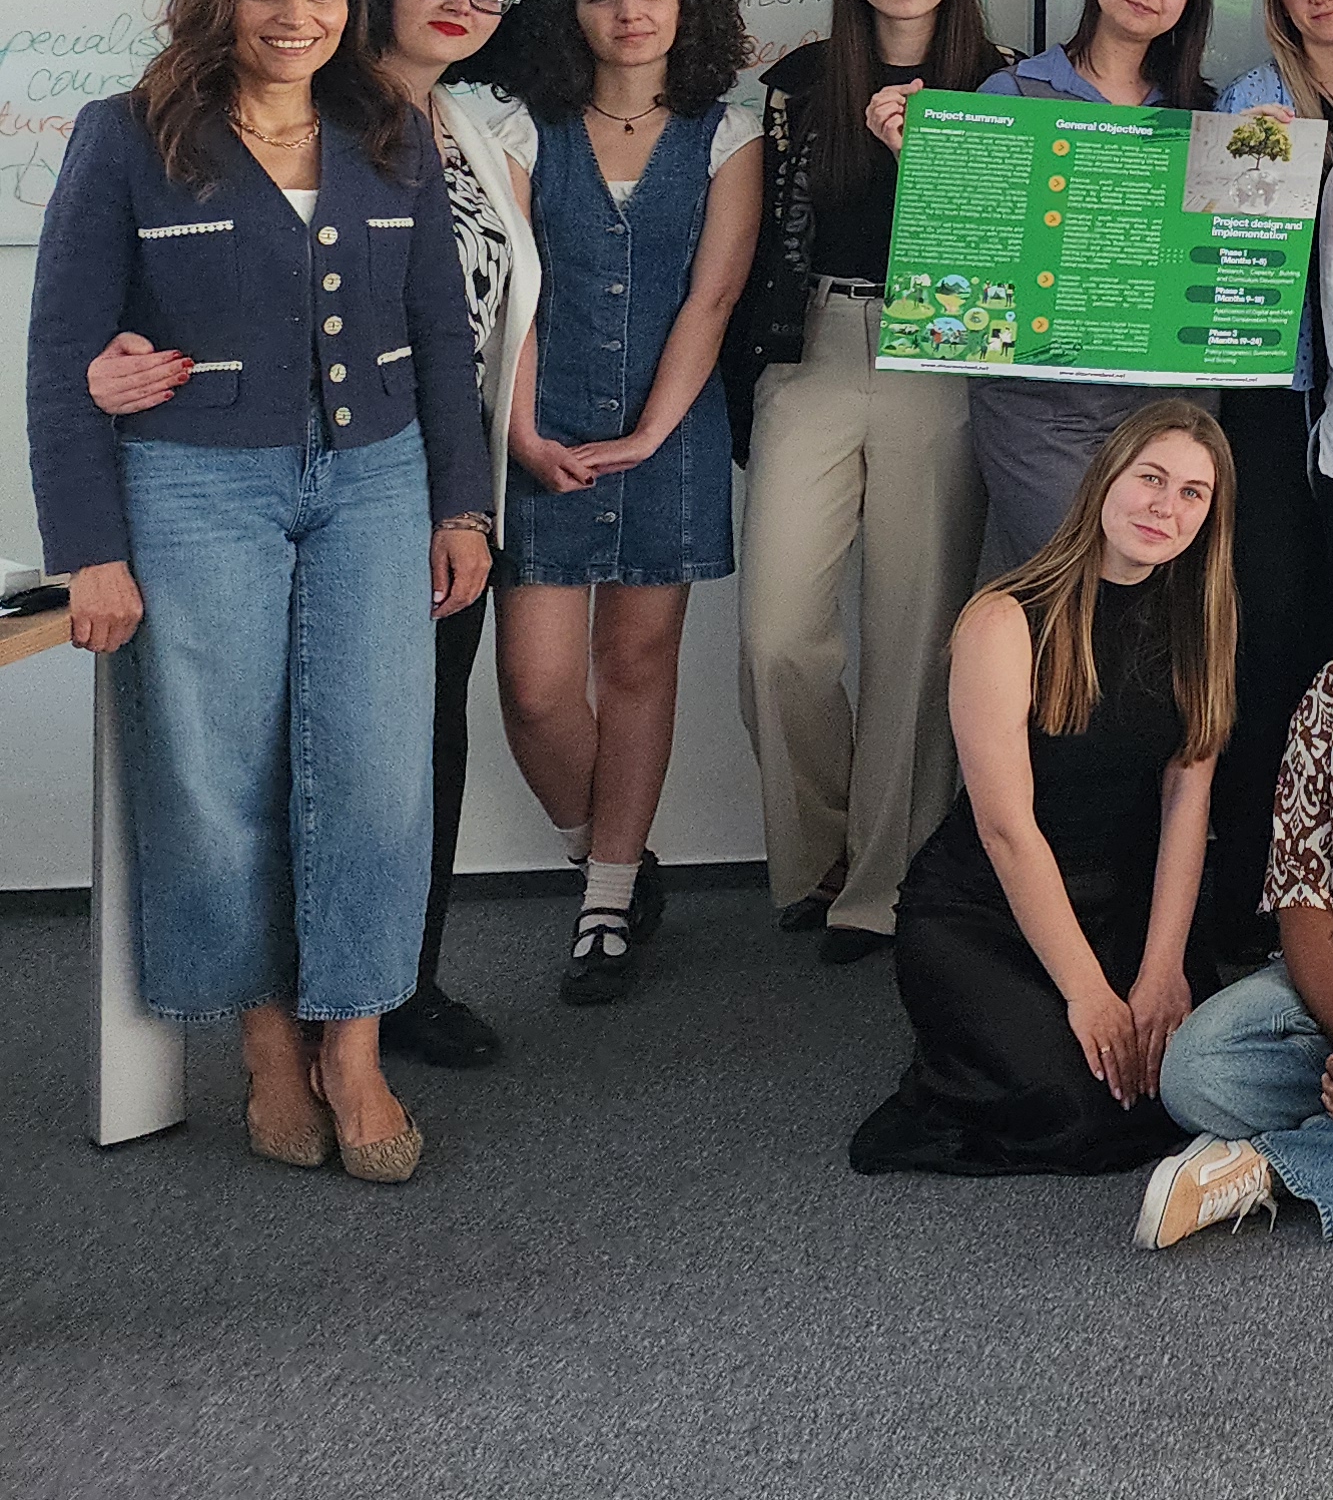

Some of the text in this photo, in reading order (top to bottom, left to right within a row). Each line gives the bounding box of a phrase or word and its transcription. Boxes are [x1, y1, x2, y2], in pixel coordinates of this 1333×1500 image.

[924, 108, 1015, 127] Project summary
[1055, 118, 1154, 136] General Objectives
[1213, 216, 1303, 231] Project design and
[1219, 248, 1242, 257] Phase
[1215, 286, 1238, 295] Phase
[1208, 329, 1232, 337] Phase
